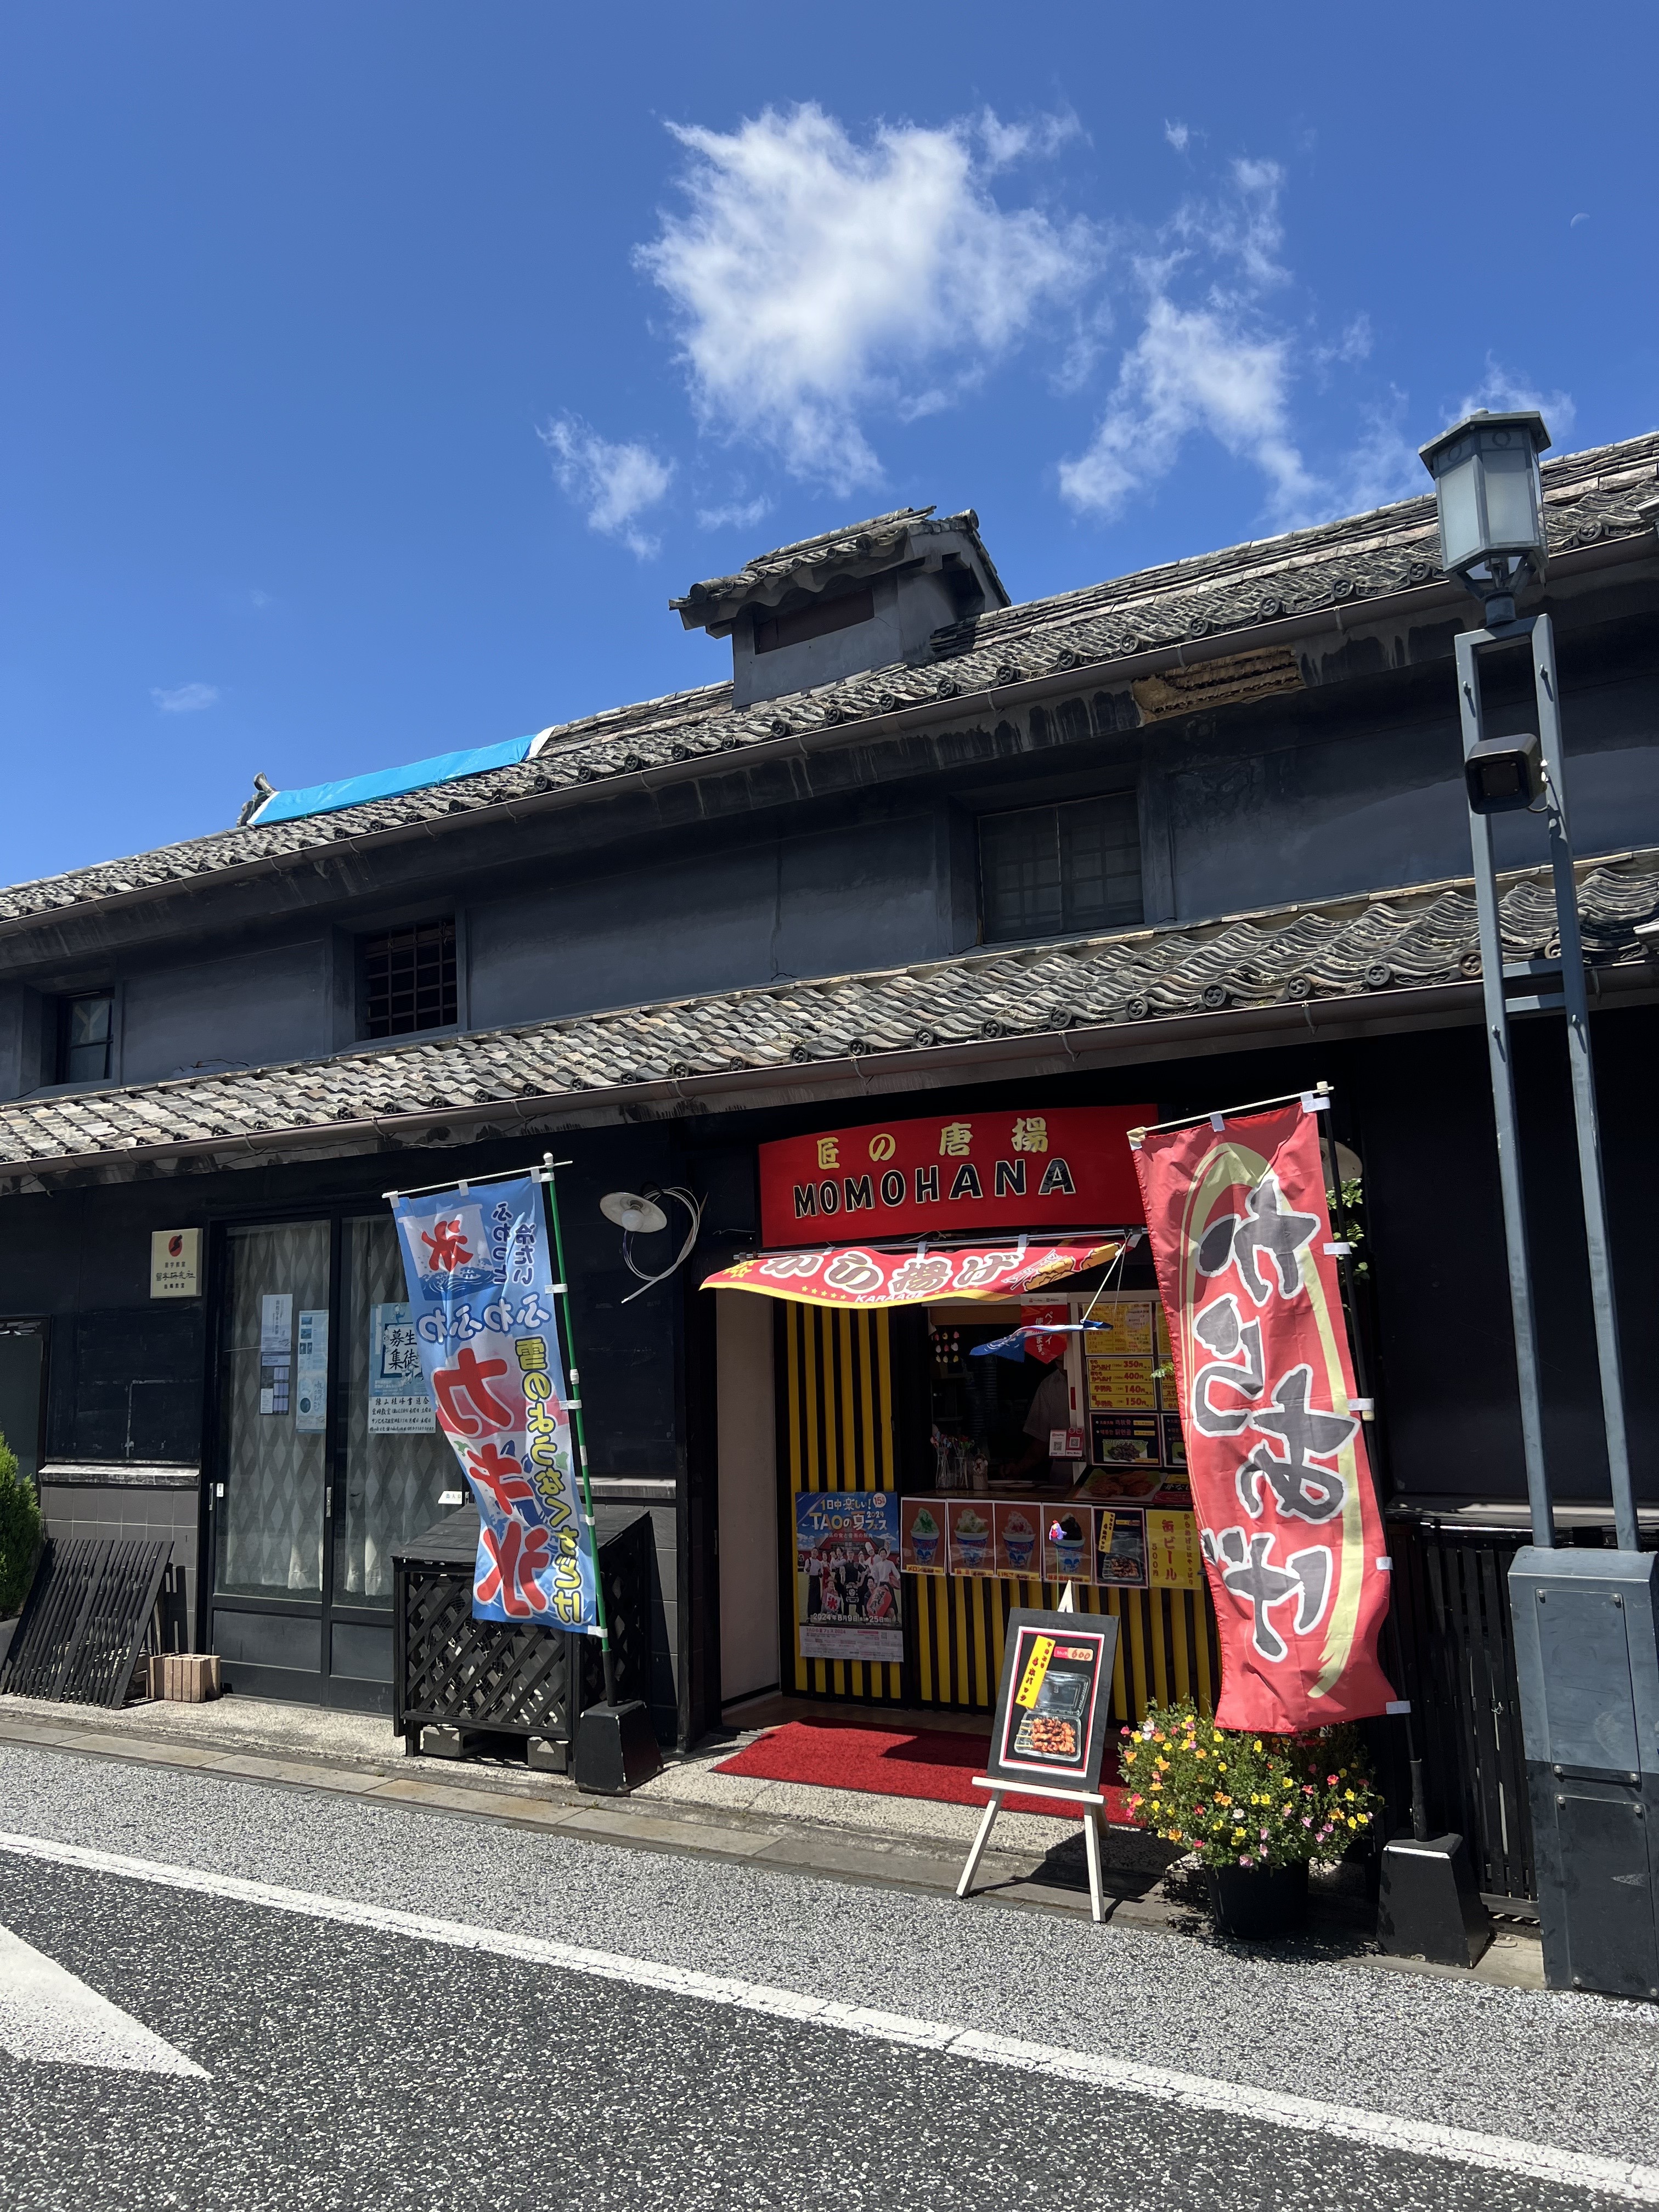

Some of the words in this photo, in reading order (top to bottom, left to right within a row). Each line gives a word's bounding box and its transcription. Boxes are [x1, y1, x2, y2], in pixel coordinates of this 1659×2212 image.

[816, 1116, 1049, 1170] 匠の唐揚
[792, 1157, 1077, 1219] MOMOHANA
[759, 1250, 1024, 1295] から揚げ
[1161, 1519, 1177, 1581] 缶ビール
[1071, 1649, 1091, 1660] 600
